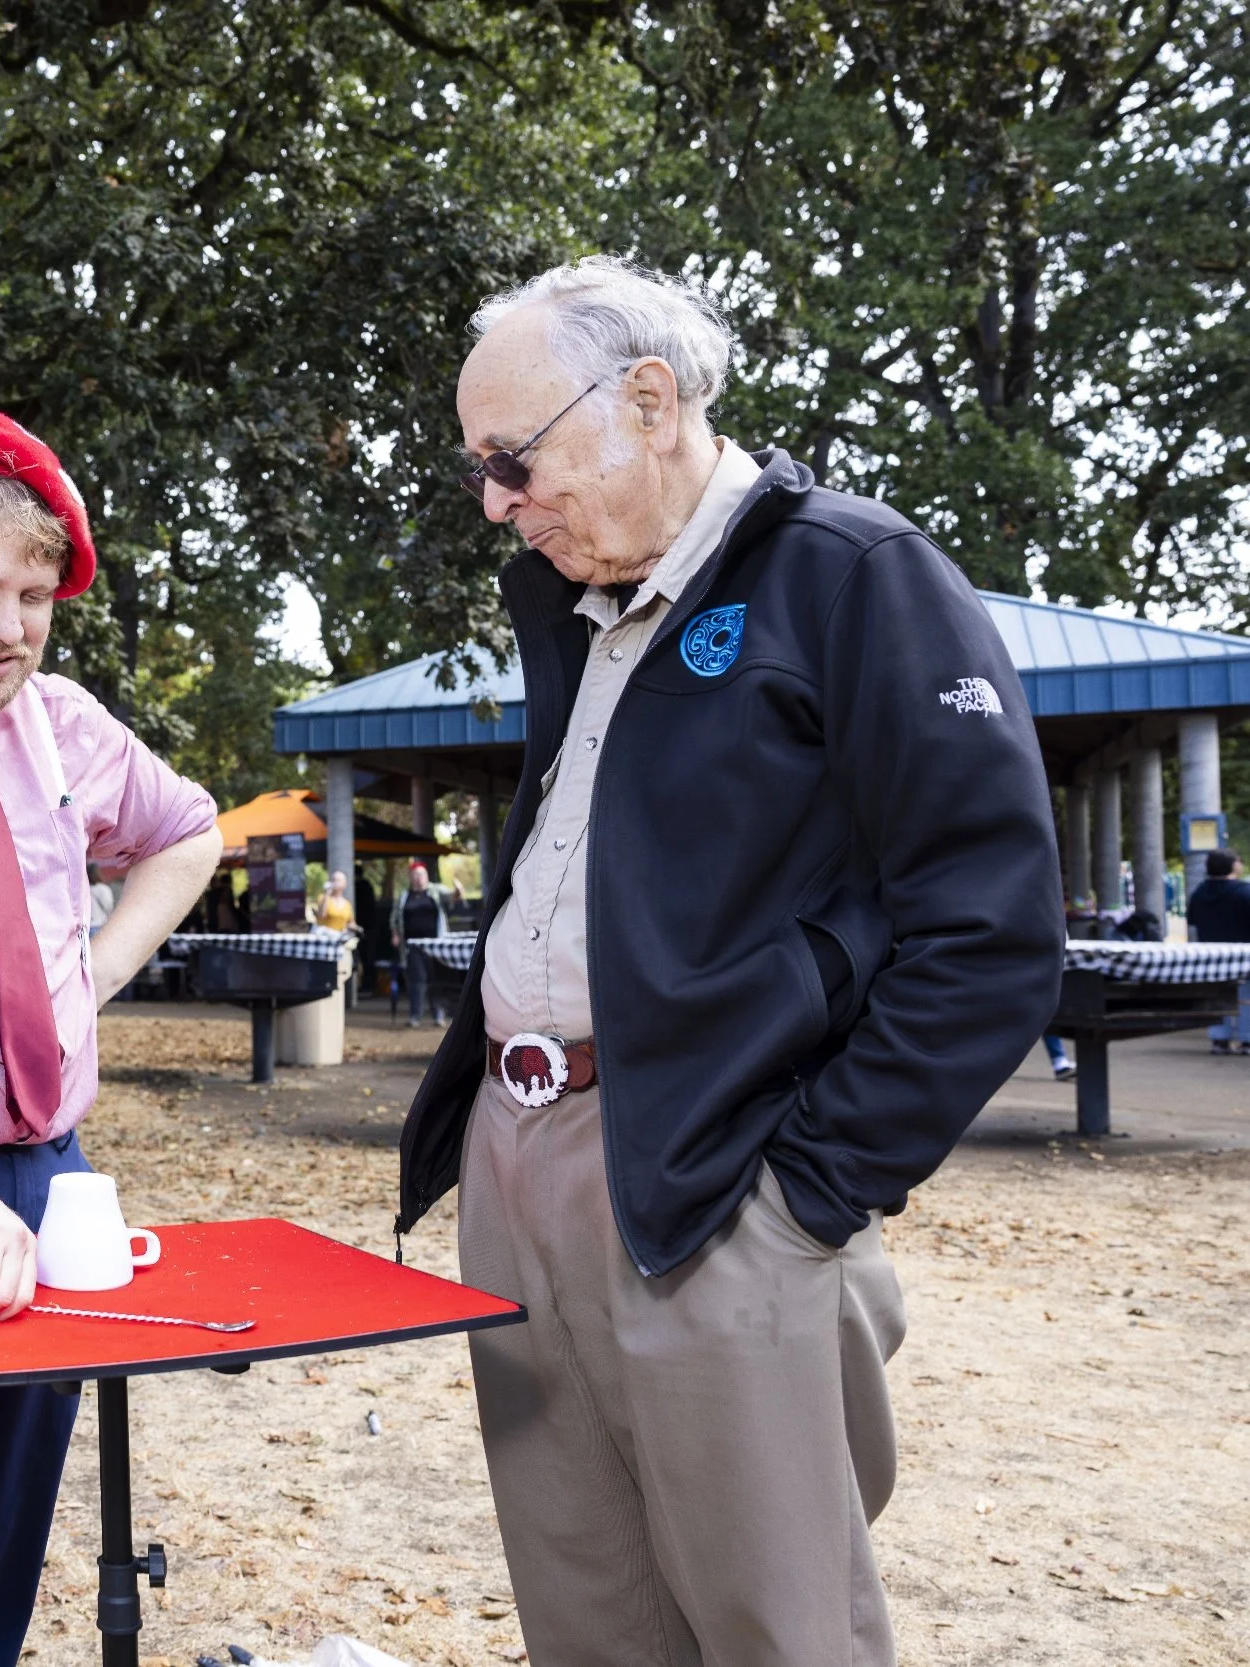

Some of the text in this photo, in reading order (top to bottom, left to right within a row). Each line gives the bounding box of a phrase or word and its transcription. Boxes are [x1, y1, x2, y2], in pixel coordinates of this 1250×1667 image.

[956, 677, 984, 690] THE
[938, 688, 986, 705] NORTH
[955, 699, 990, 714] FACE
